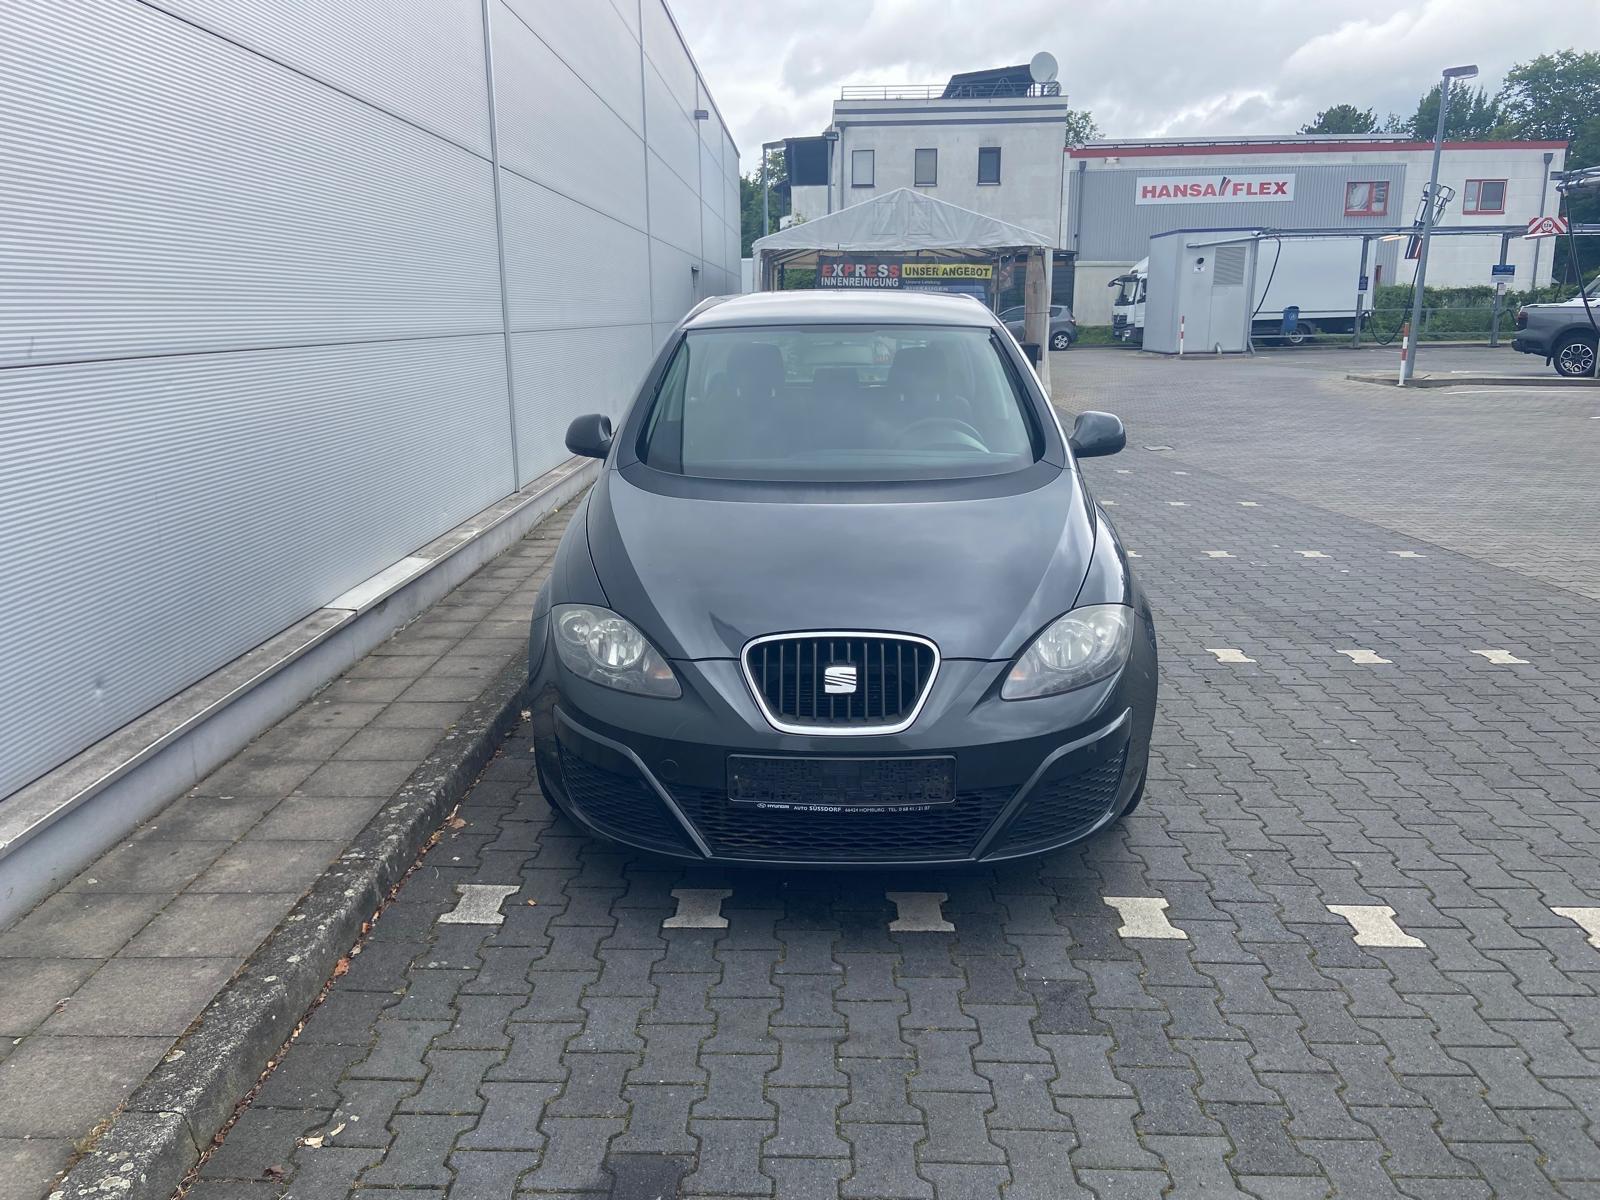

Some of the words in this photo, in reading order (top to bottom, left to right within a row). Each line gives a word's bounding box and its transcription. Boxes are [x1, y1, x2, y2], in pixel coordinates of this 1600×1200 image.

[1141, 183, 1217, 199] HANSA
[1231, 181, 1288, 196] FLEX
[821, 264, 900, 278] EXPRESS
[904, 265, 939, 276] UNSER
[942, 266, 991, 277] ANGEBOT
[821, 277, 899, 287] INNENREINIGUNG
